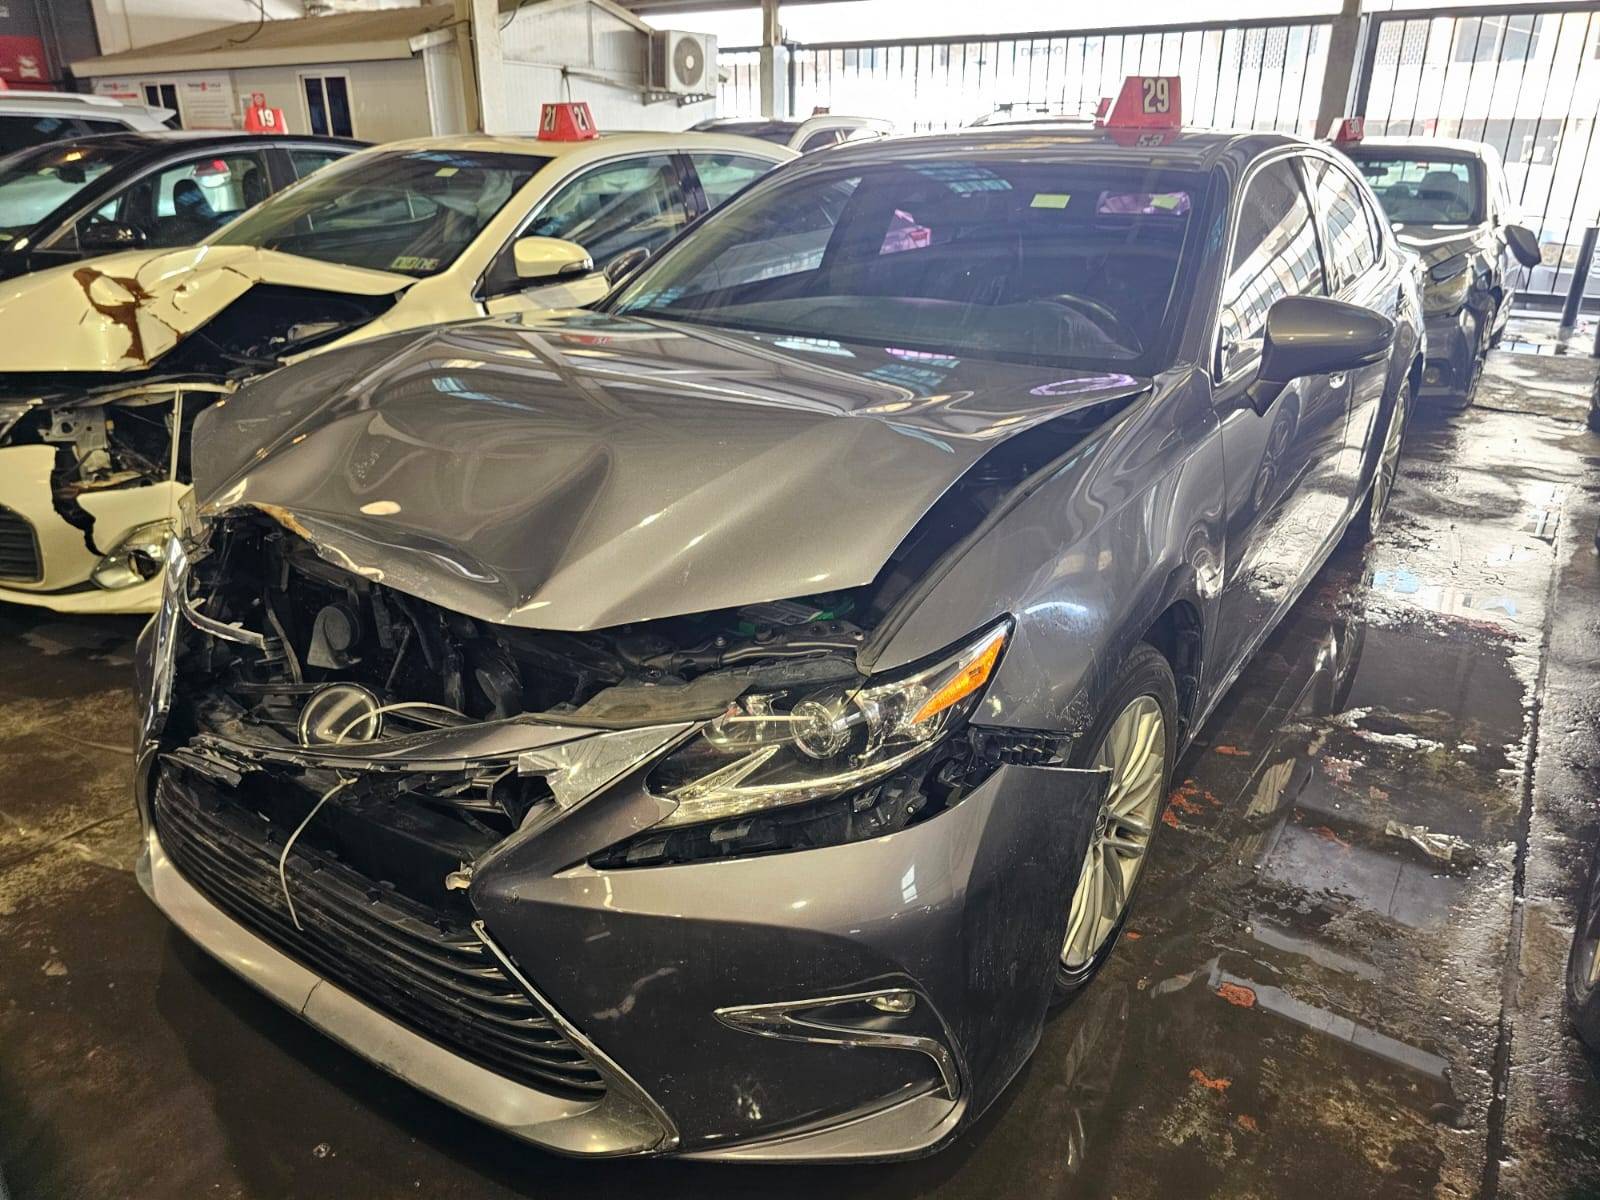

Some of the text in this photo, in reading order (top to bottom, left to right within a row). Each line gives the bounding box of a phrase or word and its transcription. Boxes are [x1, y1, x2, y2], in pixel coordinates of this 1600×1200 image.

[1143, 78, 1170, 113] 29
[257, 108, 276, 128] 19
[544, 105, 556, 131] 21
[573, 104, 591, 131] 21
